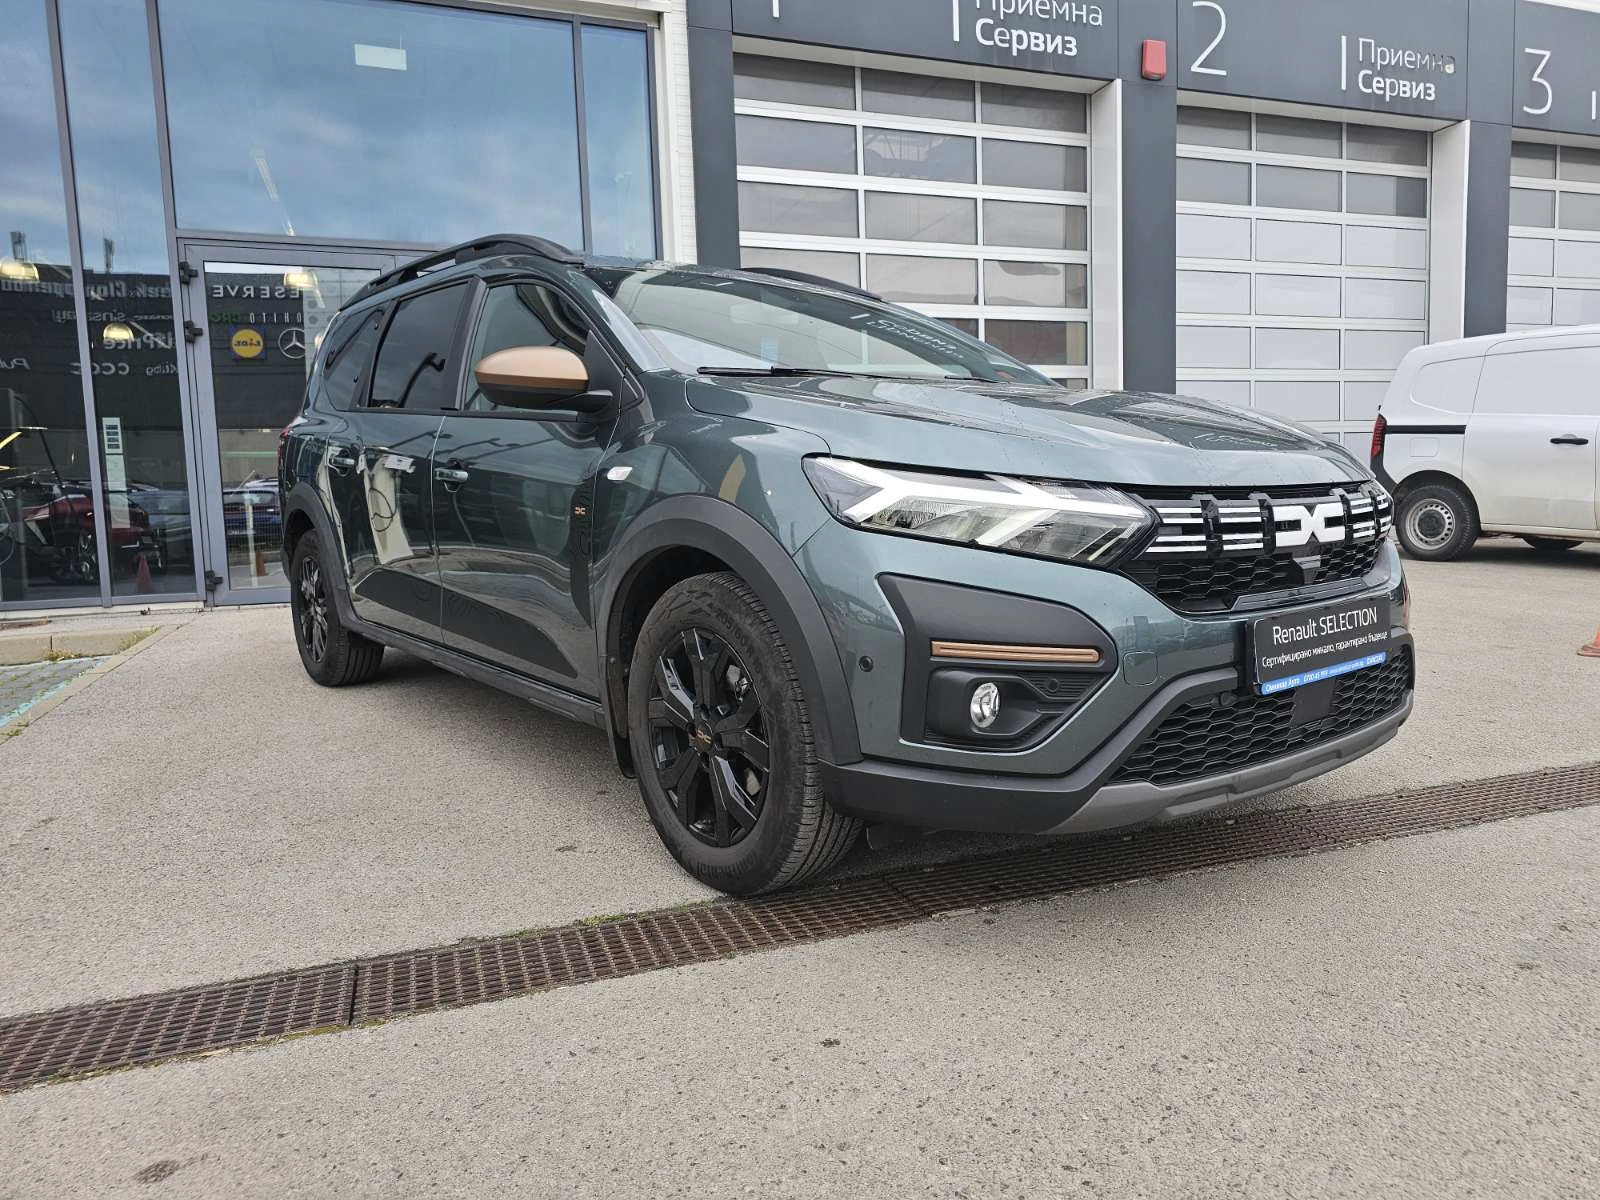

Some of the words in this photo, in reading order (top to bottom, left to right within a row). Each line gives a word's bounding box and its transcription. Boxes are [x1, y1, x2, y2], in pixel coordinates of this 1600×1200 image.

[975, 18, 1078, 57] Сервиз
[1190, 1, 1228, 76] 2
[1358, 37, 1456, 74] Приемна
[1358, 69, 1436, 101] Сервиз
[1522, 47, 1553, 116] 3
[1272, 618, 1318, 646] Renault
[1319, 606, 1378, 636] SELECTION
